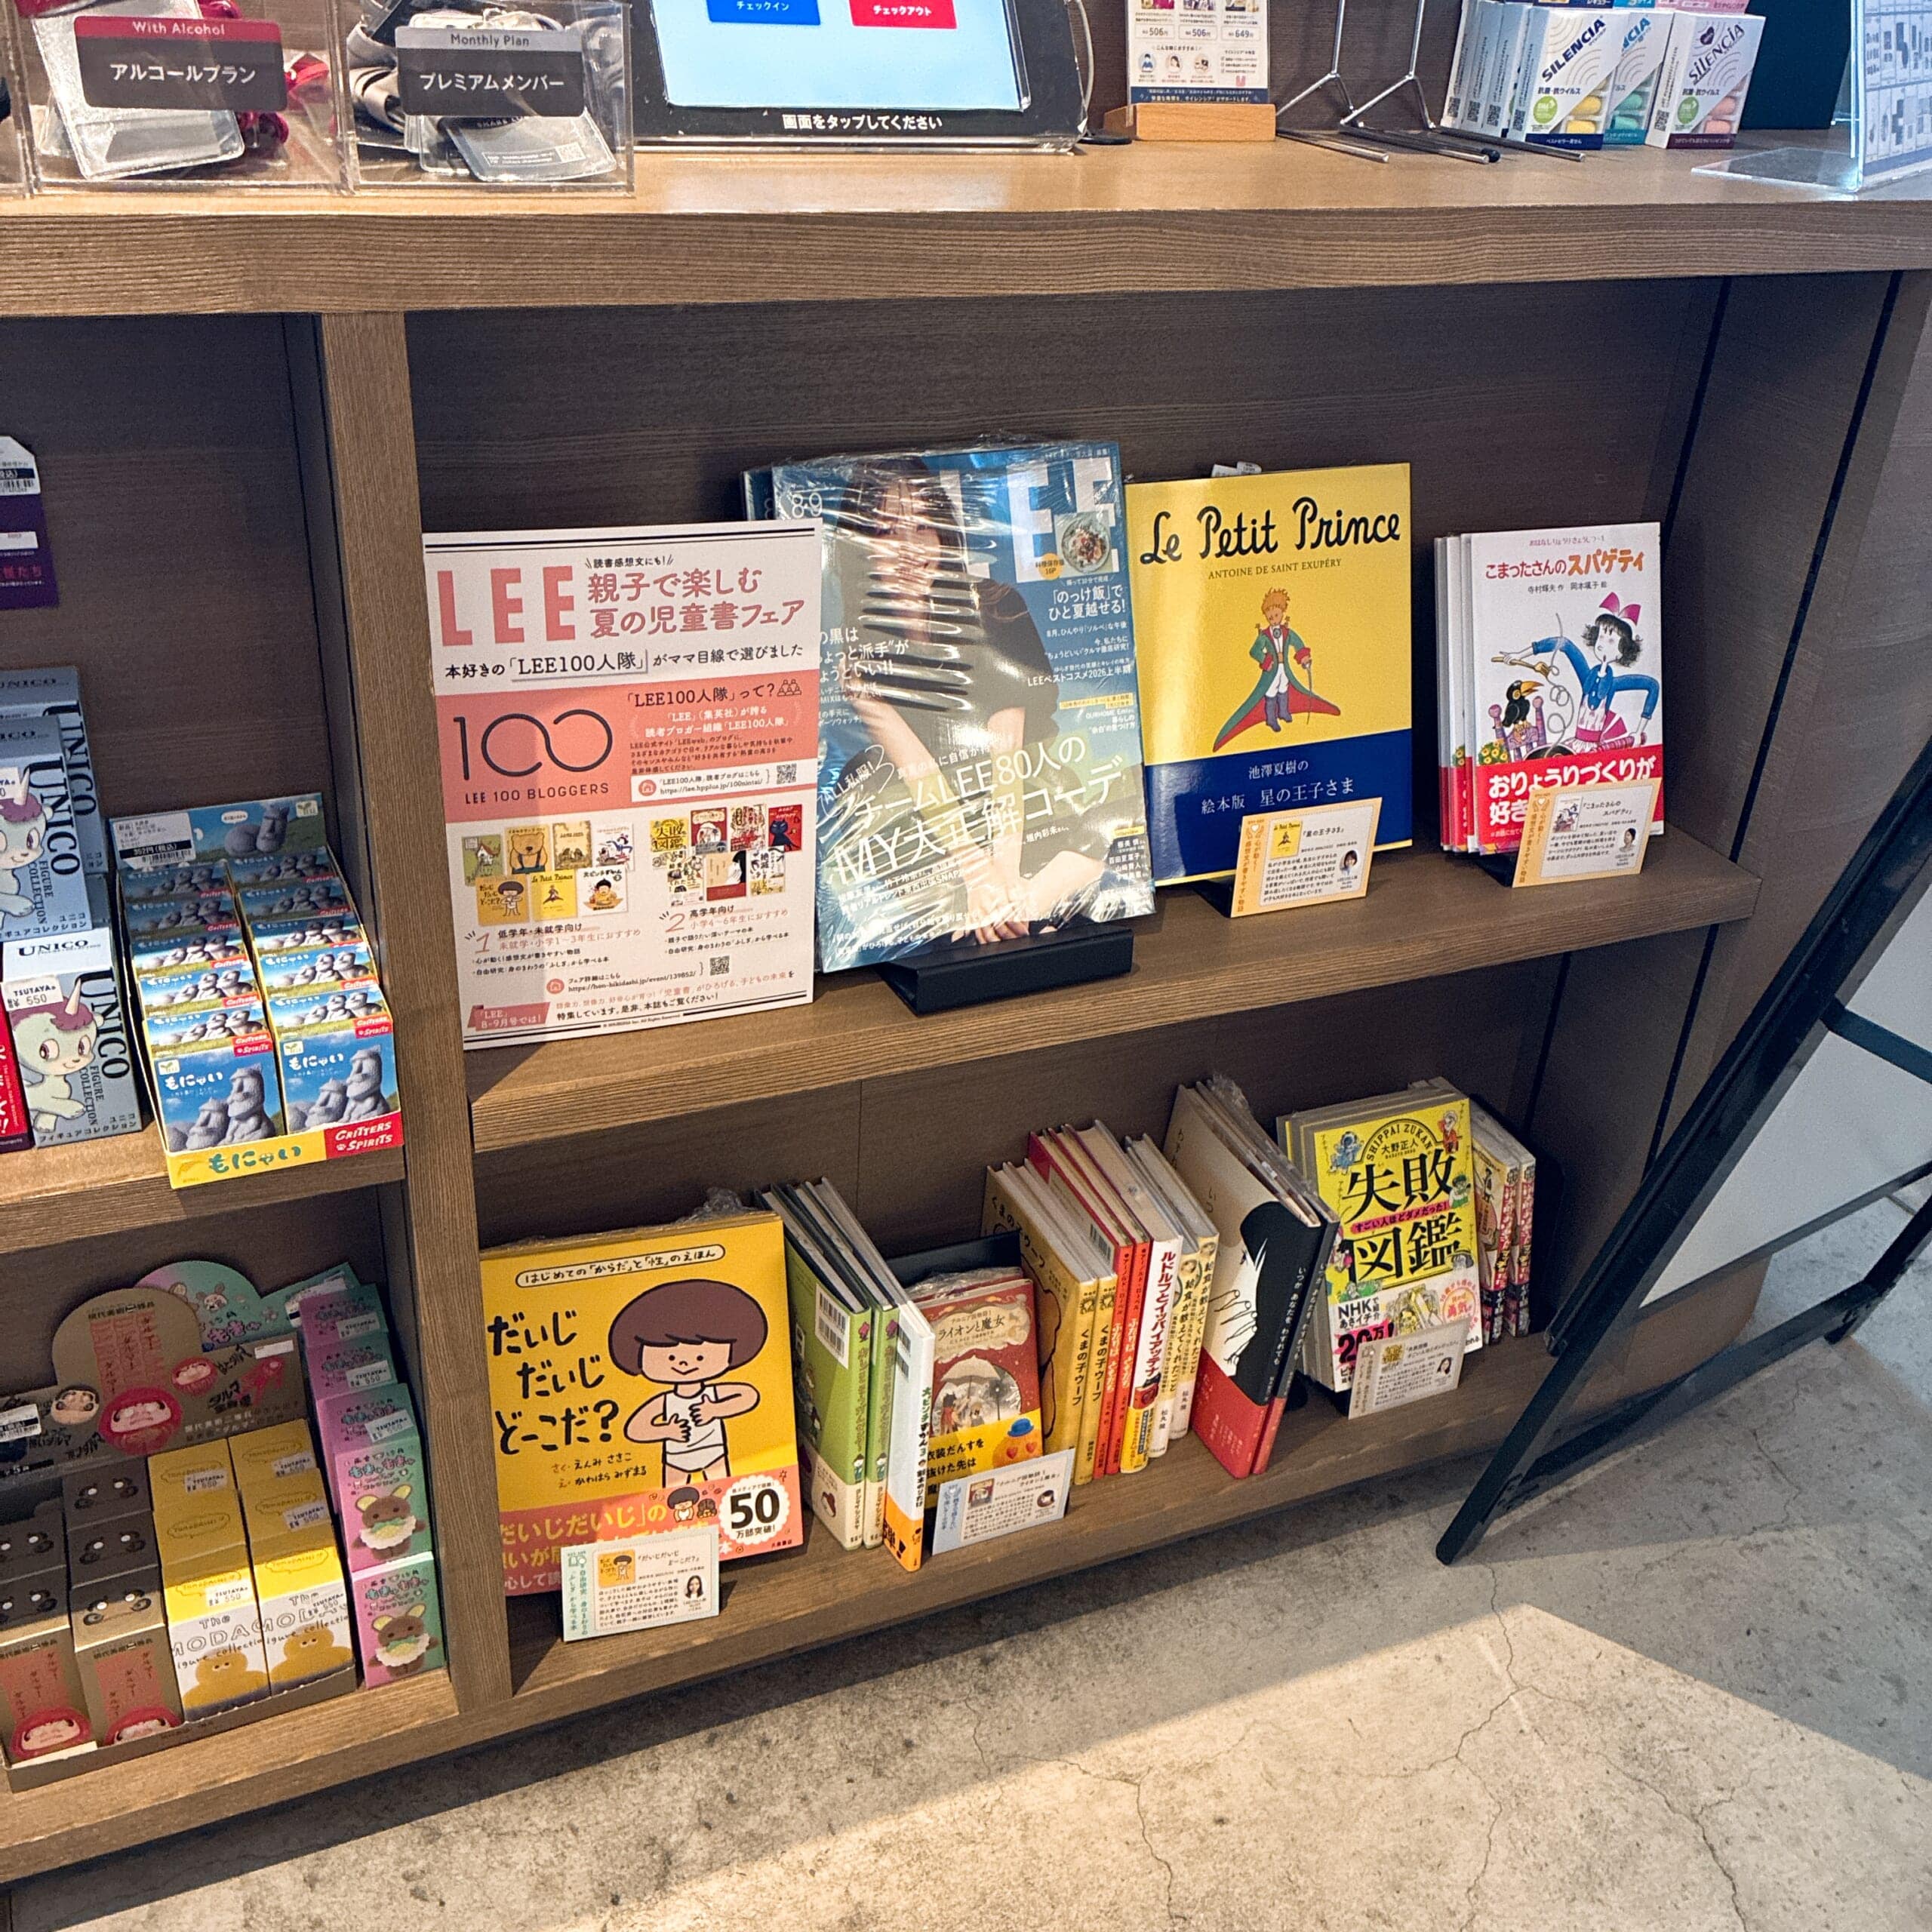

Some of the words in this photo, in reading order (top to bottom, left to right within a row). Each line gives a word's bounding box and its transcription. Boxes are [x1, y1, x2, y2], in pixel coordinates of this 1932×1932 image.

[872, 5, 932, 17] チェックアウト
[132, 21, 167, 35] With
[172, 22, 226, 35] Alcohol
[451, 33, 499, 49] Monthly
[503, 35, 530, 48] Plan
[1542, 17, 1606, 82] SILENCIA
[420, 73, 565, 93] プレミアムメンバー
[782, 114, 943, 131] 画面をタップしてください
[1140, 511, 1183, 565] Le
[1197, 506, 1280, 559] Petit
[1292, 496, 1401, 551] Prince
[594, 557, 666, 569] 読書感想文にも!
[1208, 567, 1253, 580] ANTOINE
[1255, 565, 1269, 575] DE
[1271, 562, 1299, 574] SAINT
[1301, 558, 1342, 571] EXUPÉRY
[1485, 548, 1644, 580] こまったさんのスパゲティ
[587, 568, 761, 605] 親子で楽しむ
[1053, 584, 1123, 605] 「のっけ飯」で
[438, 566, 576, 647] LEE
[591, 599, 804, 638] 夏の児童書フェア
[1048, 599, 1126, 621] ひと夏越せる!
[1248, 759, 1309, 780] 池澤夏樹の
[1489, 755, 1657, 798] おりょうりづくりが
[465, 792, 487, 804] LEE
[494, 789, 521, 802] 100
[528, 783, 610, 800] BLOGGERS
[1201, 794, 1246, 814] 絵本版
[1260, 777, 1354, 808] 星の王子さま
[23, 756, 80, 875] UNICO
[39, 860, 54, 898] FIGURE
[60, 912, 86, 922] ユニコ
[690, 905, 734, 918] 高学年向け
[18, 940, 89, 956] UNICO
[14, 985, 51, 997] TSUTAYA
[26, 994, 48, 1005] 550
[75, 967, 130, 1079] UNICO
[288, 1052, 344, 1071] もにゃい
[90, 1065, 104, 1101] FIGURE
[165, 1072, 224, 1090] もにゃい
[79, 1066, 97, 1126] COLLECTION
[109, 1113, 136, 1123] ユニコ
[335, 1121, 392, 1141] CRITTERS
[346, 1134, 393, 1152] SPIRITS
[1366, 1124, 1401, 1161] SHIPPAI
[1403, 1124, 1432, 1149] ZUKAN
[1381, 1138, 1420, 1155] 大野正人
[208, 1146, 302, 1174] もにゃい
[1342, 1149, 1457, 1224] 失敗
[1355, 1201, 1447, 1232] すごい人ほどダメだった!
[1343, 1212, 1463, 1283] 図鑑
[525, 1250, 716, 1284] はじめての「からだ」と「性」のえほん
[1294, 1268, 1306, 1289] いつか
[1145, 1251, 1176, 1377] ルドルフとイッパイアッテナ
[1190, 1261, 1214, 1374] 給食が教えてくれたこと
[1285, 1293, 1299, 1324] あなたを
[1338, 1298, 1371, 1319] NHK
[1340, 1313, 1372, 1329] あさイチ
[488, 1309, 577, 1356] だいじ
[939, 1315, 1006, 1342] ライオンと魔女
[1170, 1278, 1195, 1392] 給食が教えてくれたこと
[1275, 1327, 1290, 1366] わすれても
[1072, 1328, 1089, 1407] くまの子ウーフ
[1092, 1324, 1109, 1401] くまの子ウーフ
[516, 1354, 605, 1399] だいじ
[495, 1398, 620, 1455] どーこだ?
[574, 1457, 602, 1471] えんみ
[608, 1452, 632, 1466] ささこ
[574, 1472, 612, 1486] かわはら
[614, 1468, 648, 1483] みずまる
[730, 1488, 780, 1530] 50
[737, 1524, 775, 1539] 万部突破!
[199, 1615, 231, 1629] The
